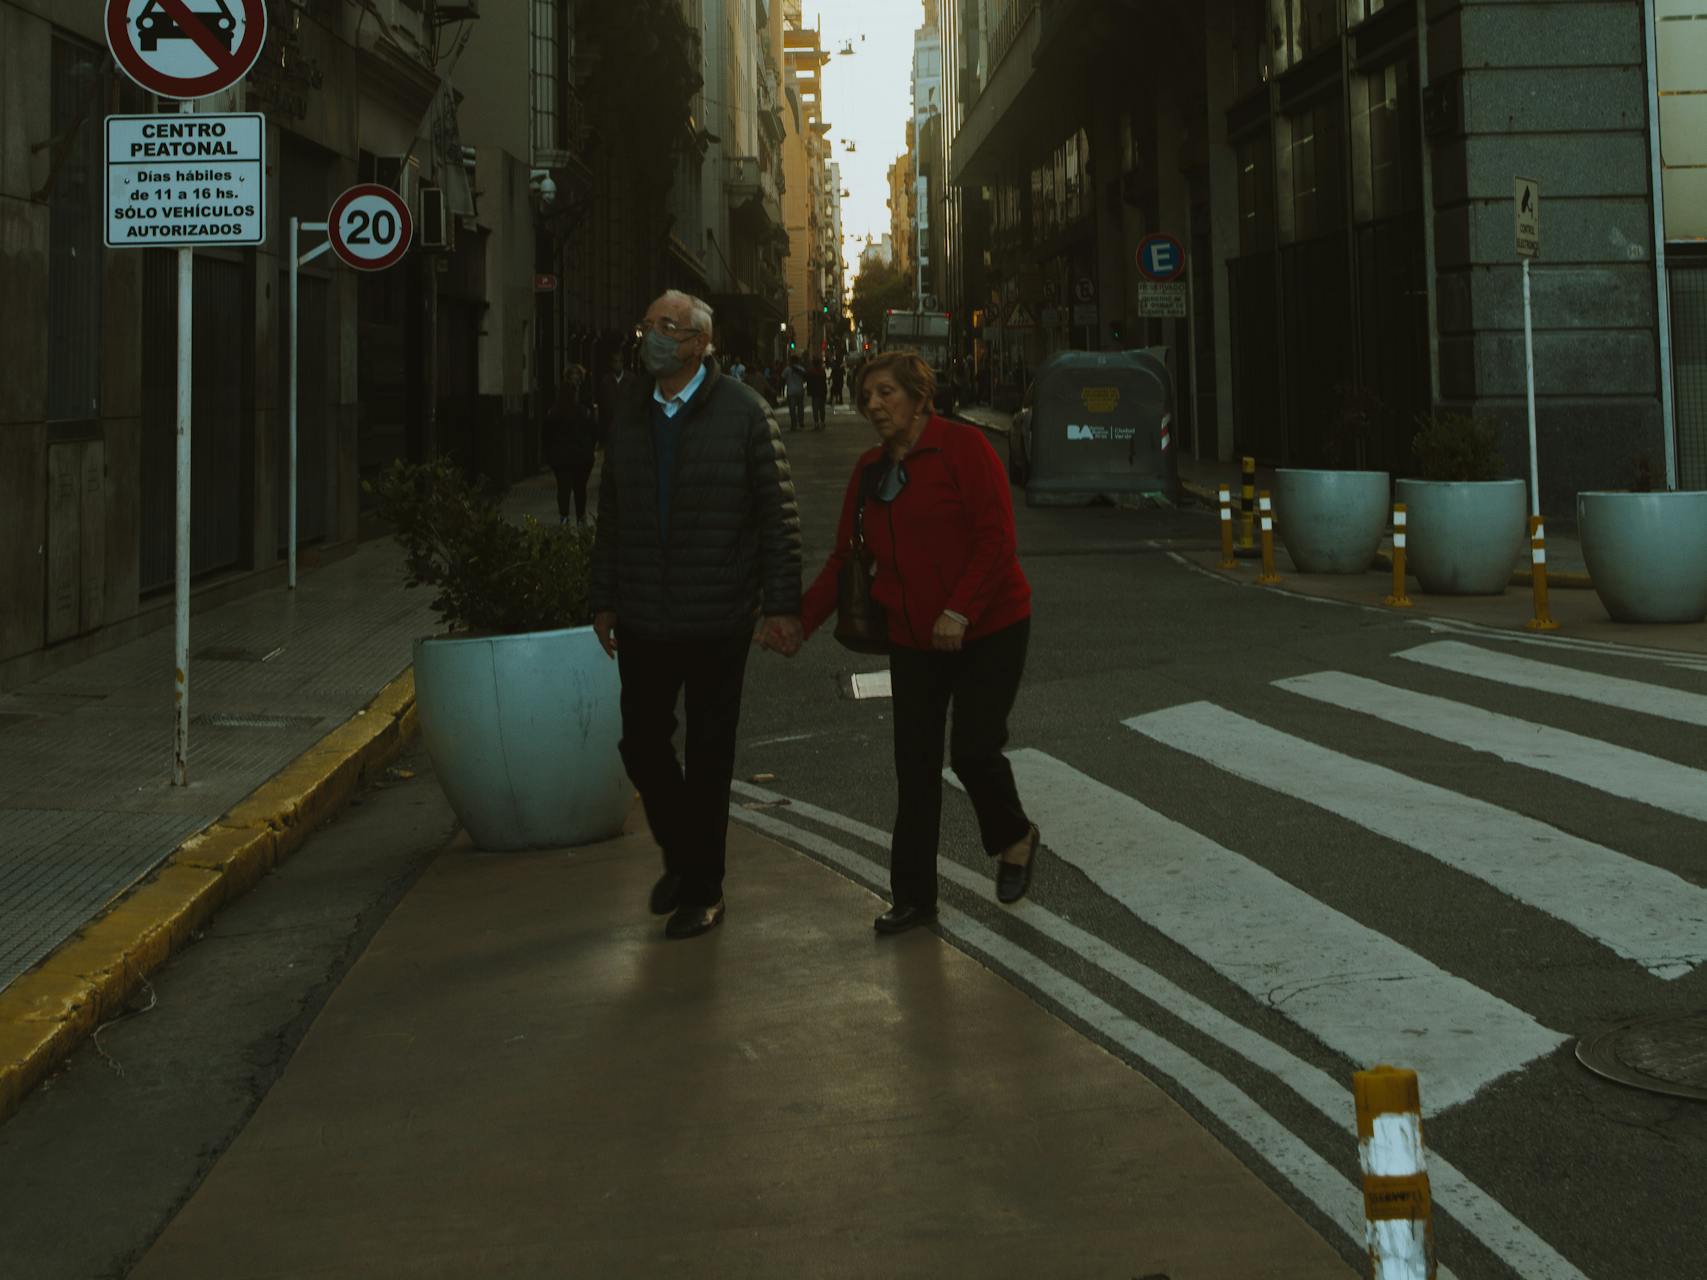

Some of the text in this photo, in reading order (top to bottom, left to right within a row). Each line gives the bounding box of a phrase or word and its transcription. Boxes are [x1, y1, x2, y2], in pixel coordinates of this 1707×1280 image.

[142, 123, 226, 138] CENTRO
[130, 141, 238, 156] PEATONAL
[137, 170, 232, 182] Días hábiles
[130, 188, 239, 200] de 11 a 16 hs.
[114, 204, 255, 219] SÓLO VEHÍCULOS
[127, 223, 242, 237] AUTORIZADOS
[346, 210, 396, 244] 20
[1150, 242, 1174, 273] E
